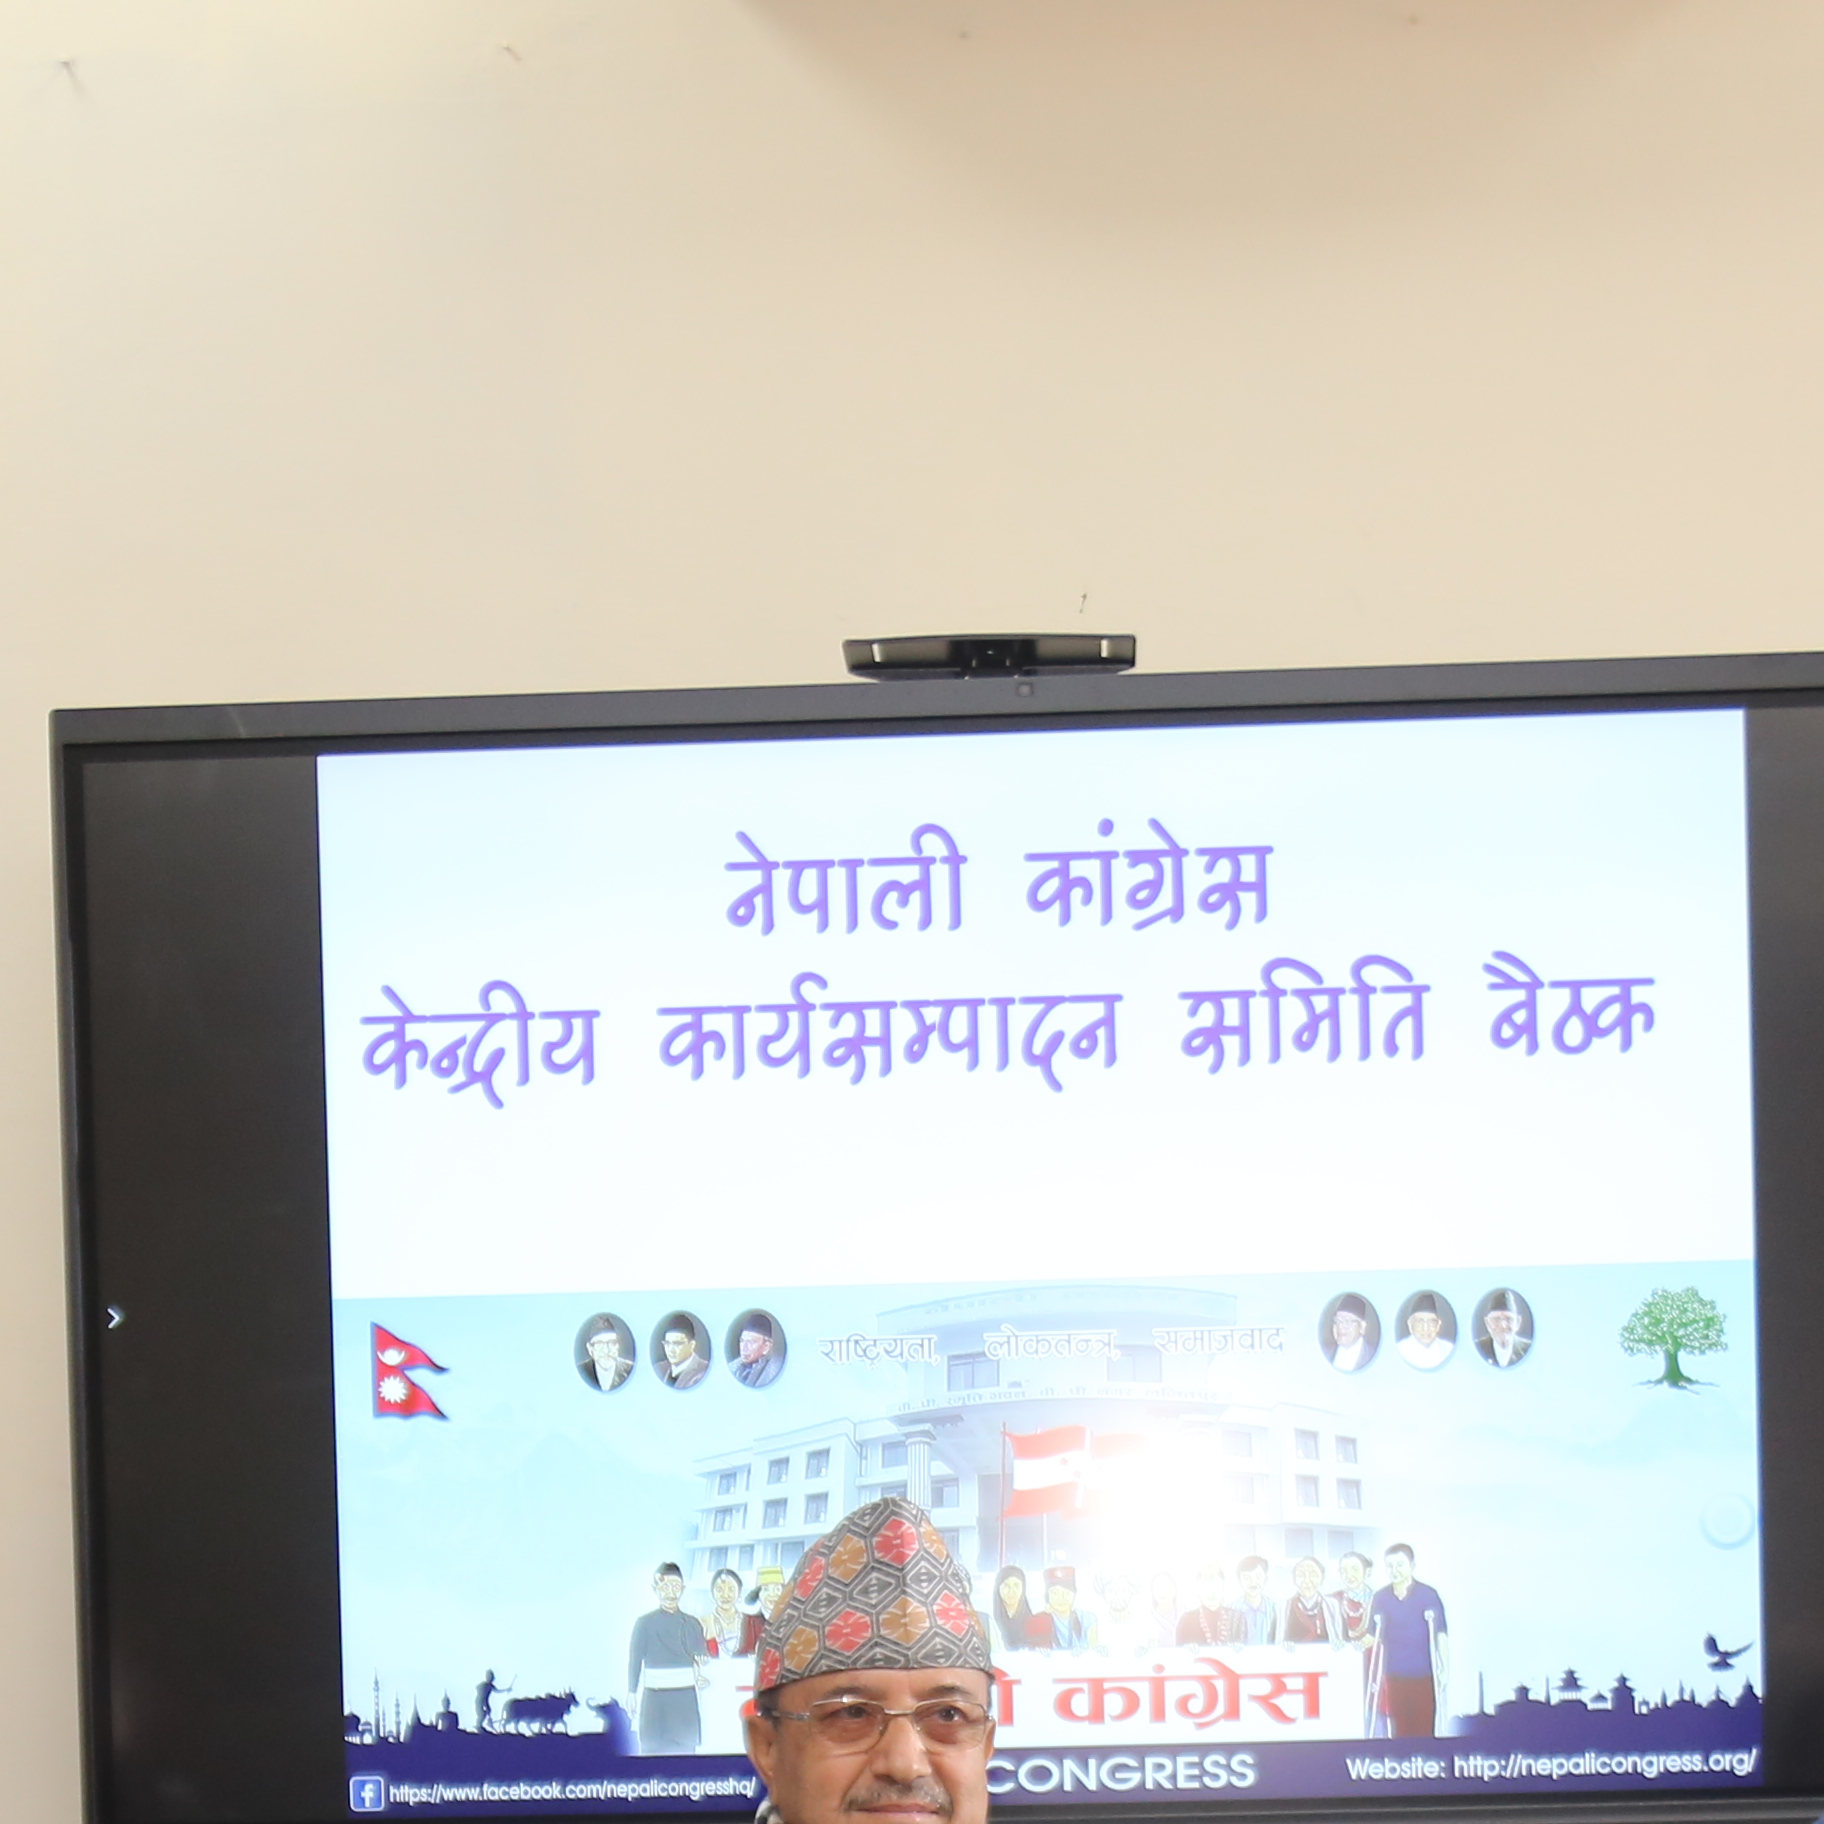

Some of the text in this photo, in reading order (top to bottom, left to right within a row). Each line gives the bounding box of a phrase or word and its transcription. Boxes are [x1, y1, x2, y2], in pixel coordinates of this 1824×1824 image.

[725, 817, 1275, 936] नेपाली कांग्रेस
[360, 949, 1655, 1110] केन्द्रीय कार्यसम्पादन समिति बैठक
[1052, 1657, 1328, 1730] कांग्रेस
[389, 1776, 757, 1806] https://www.facebook.com/nepalicongresshq/
[985, 1753, 1257, 1795] CONGRESS
[1345, 1747, 1758, 1783] Website: http://nepalicongress.org/
